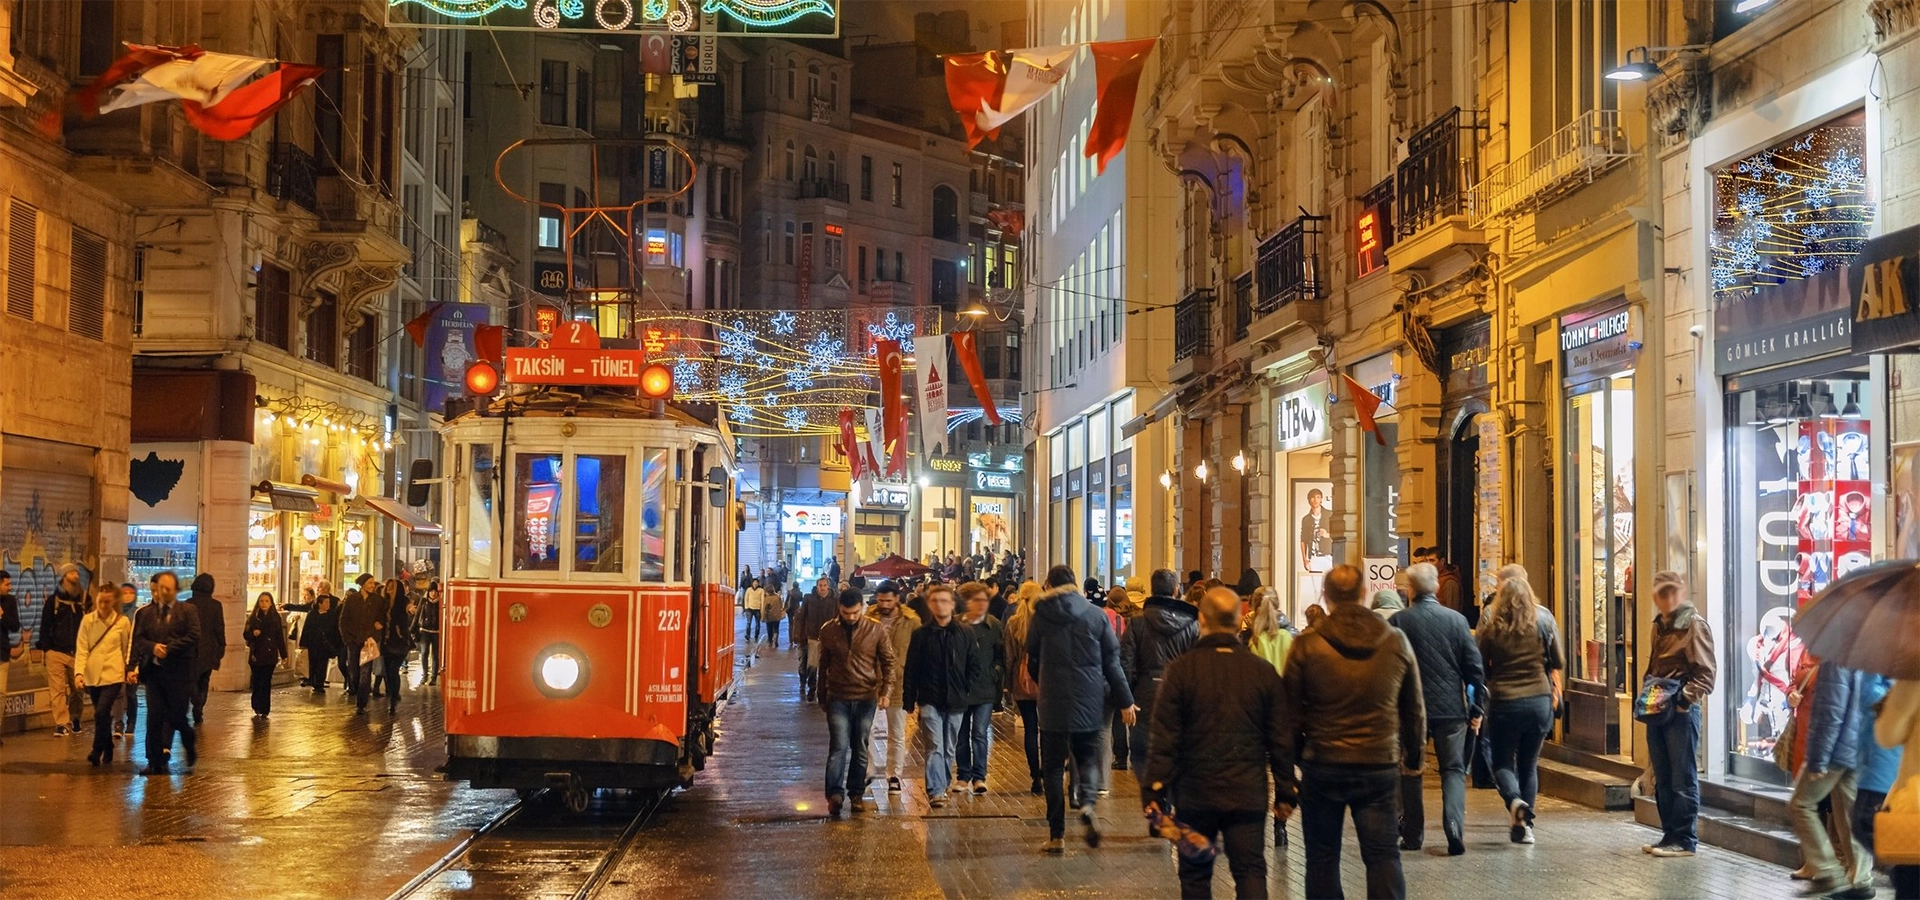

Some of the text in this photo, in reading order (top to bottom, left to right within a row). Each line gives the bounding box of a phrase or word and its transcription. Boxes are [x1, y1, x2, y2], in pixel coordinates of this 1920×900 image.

[570, 323, 581, 344] 2
[1561, 311, 1629, 351] TOMMY HILFIGER
[1727, 336, 1776, 362] GÖMLEK
[513, 354, 565, 377] TAKSİM
[591, 356, 639, 378] TÜNEL
[1278, 396, 1301, 441] LTB
[811, 513, 832, 527] avea
[451, 606, 470, 627] 223
[658, 610, 681, 631] 223
[645, 694, 653, 703] VE
